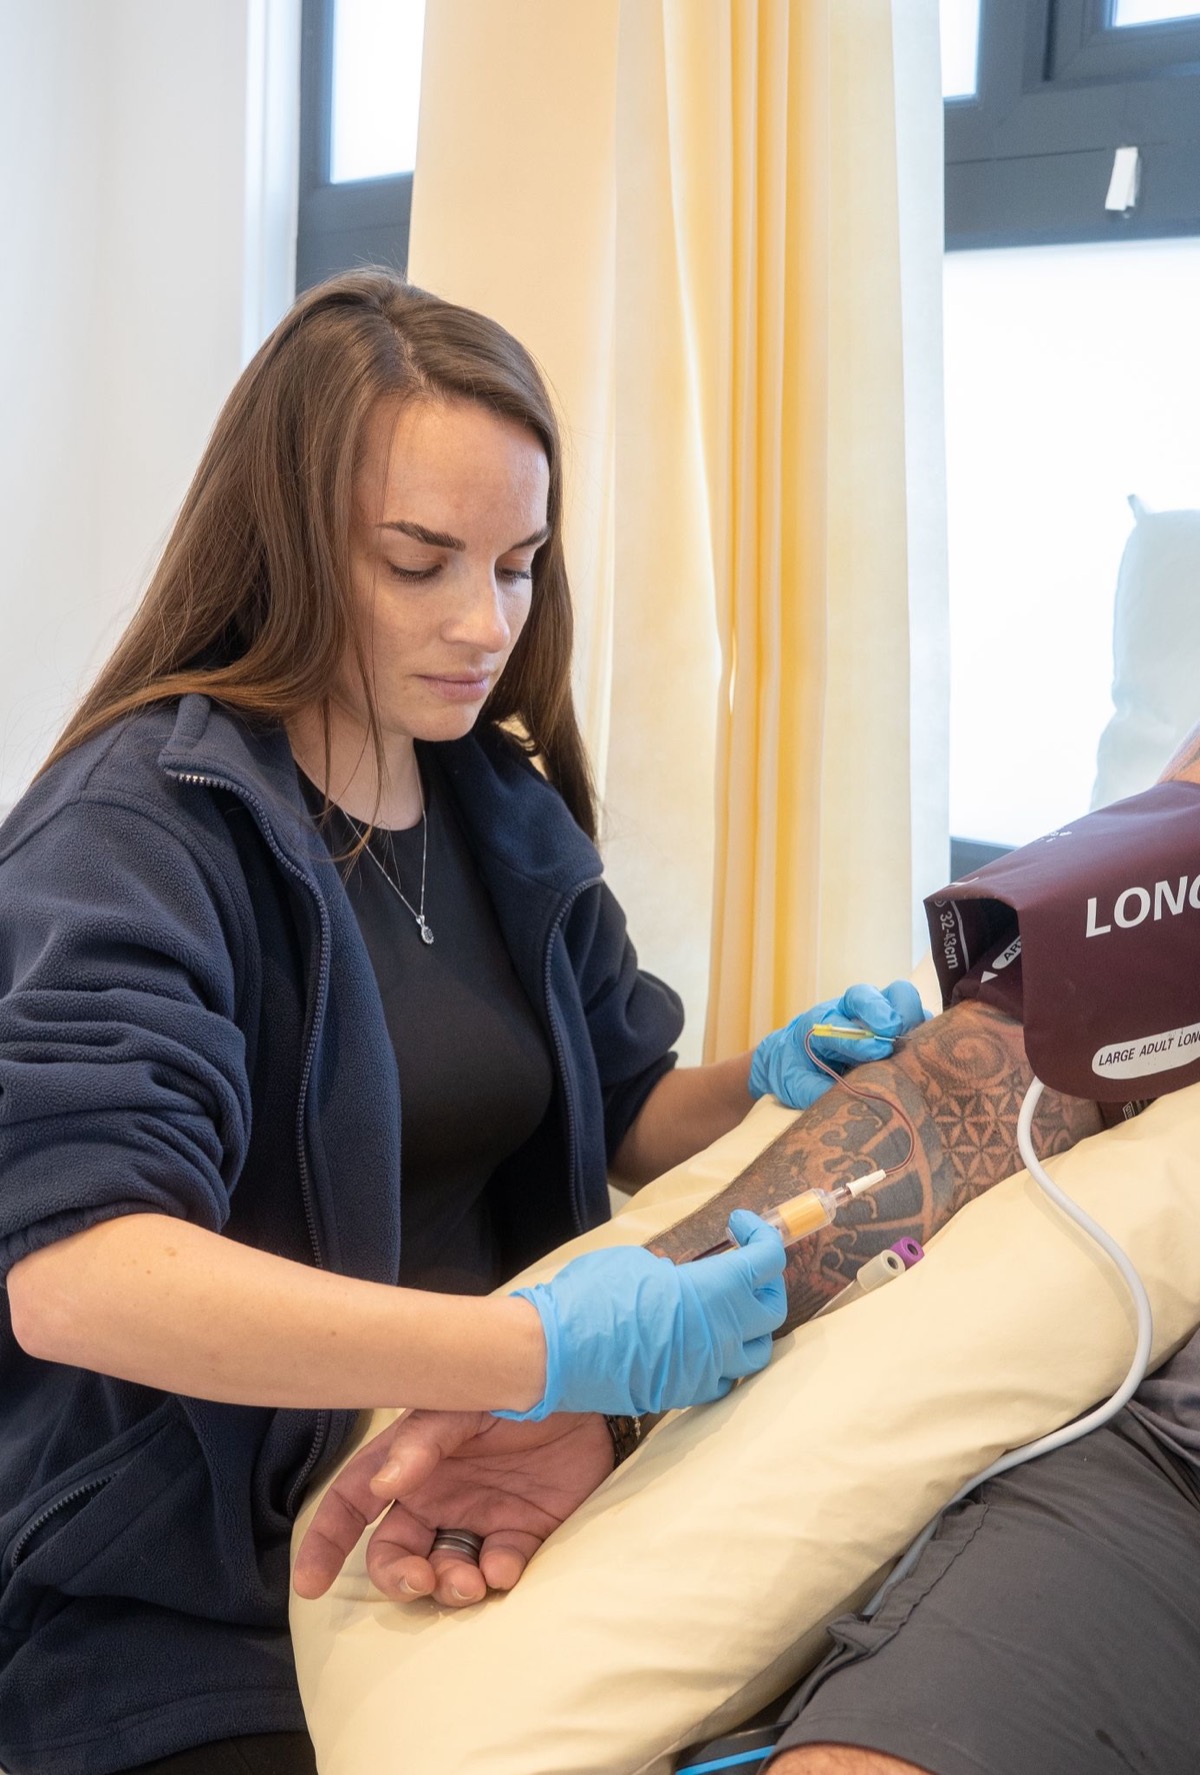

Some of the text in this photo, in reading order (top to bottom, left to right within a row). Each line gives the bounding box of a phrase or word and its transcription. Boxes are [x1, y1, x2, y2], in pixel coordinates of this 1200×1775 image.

[940, 910, 959, 969] 32-43cm
[1098, 1030, 1200, 1066] LARGE ADULT LON
